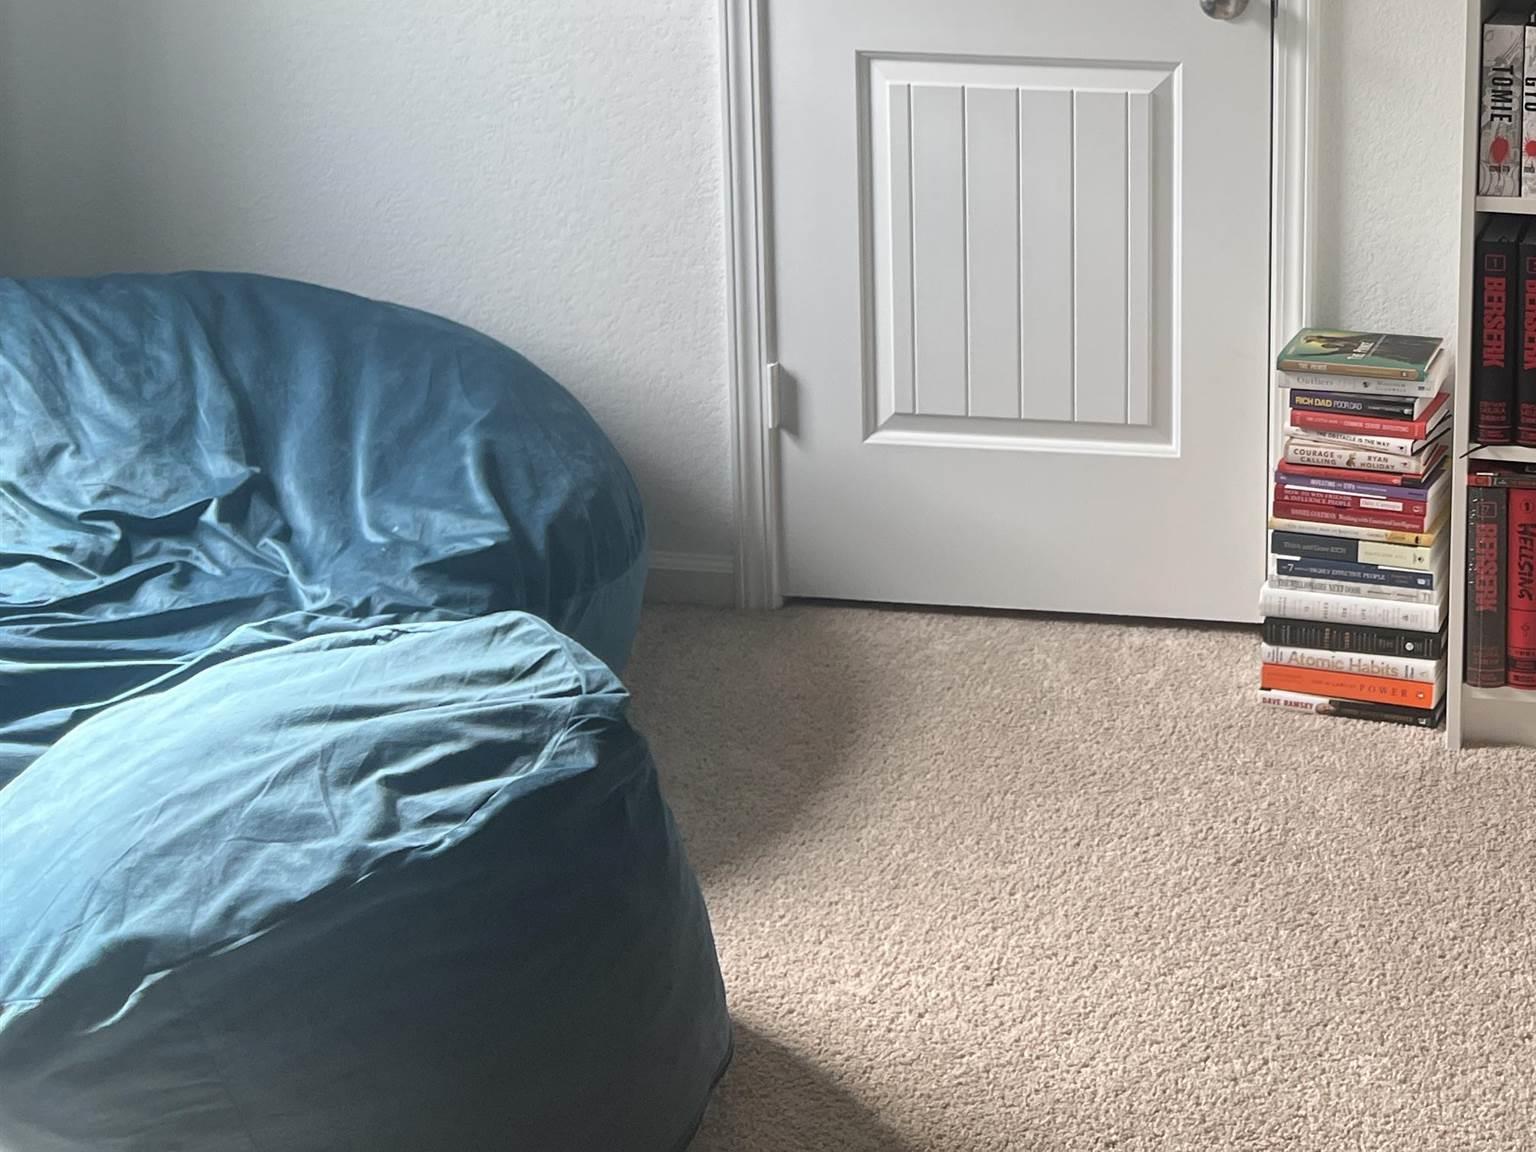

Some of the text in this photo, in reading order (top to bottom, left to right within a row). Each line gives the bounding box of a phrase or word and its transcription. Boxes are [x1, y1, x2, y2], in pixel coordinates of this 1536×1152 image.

[1490, 65, 1514, 123] TOMIE
[1482, 276, 1506, 368] BERSERK
[1295, 396, 1333, 408] RICH DAD
[1328, 433, 1356, 442] OBSTACLE
[1293, 448, 1334, 458] COURAGE
[1367, 455, 1389, 463] RYAN
[1300, 456, 1337, 466] CALLING
[1360, 462, 1396, 471] HOLIDAY
[1518, 522, 1536, 601] HELLSING
[1363, 571, 1386, 580] PEOPLE
[1287, 651, 1400, 678] Atomic Habits
[1359, 684, 1409, 697] POWER
[1262, 697, 1314, 710] DAVE RAMSEY
